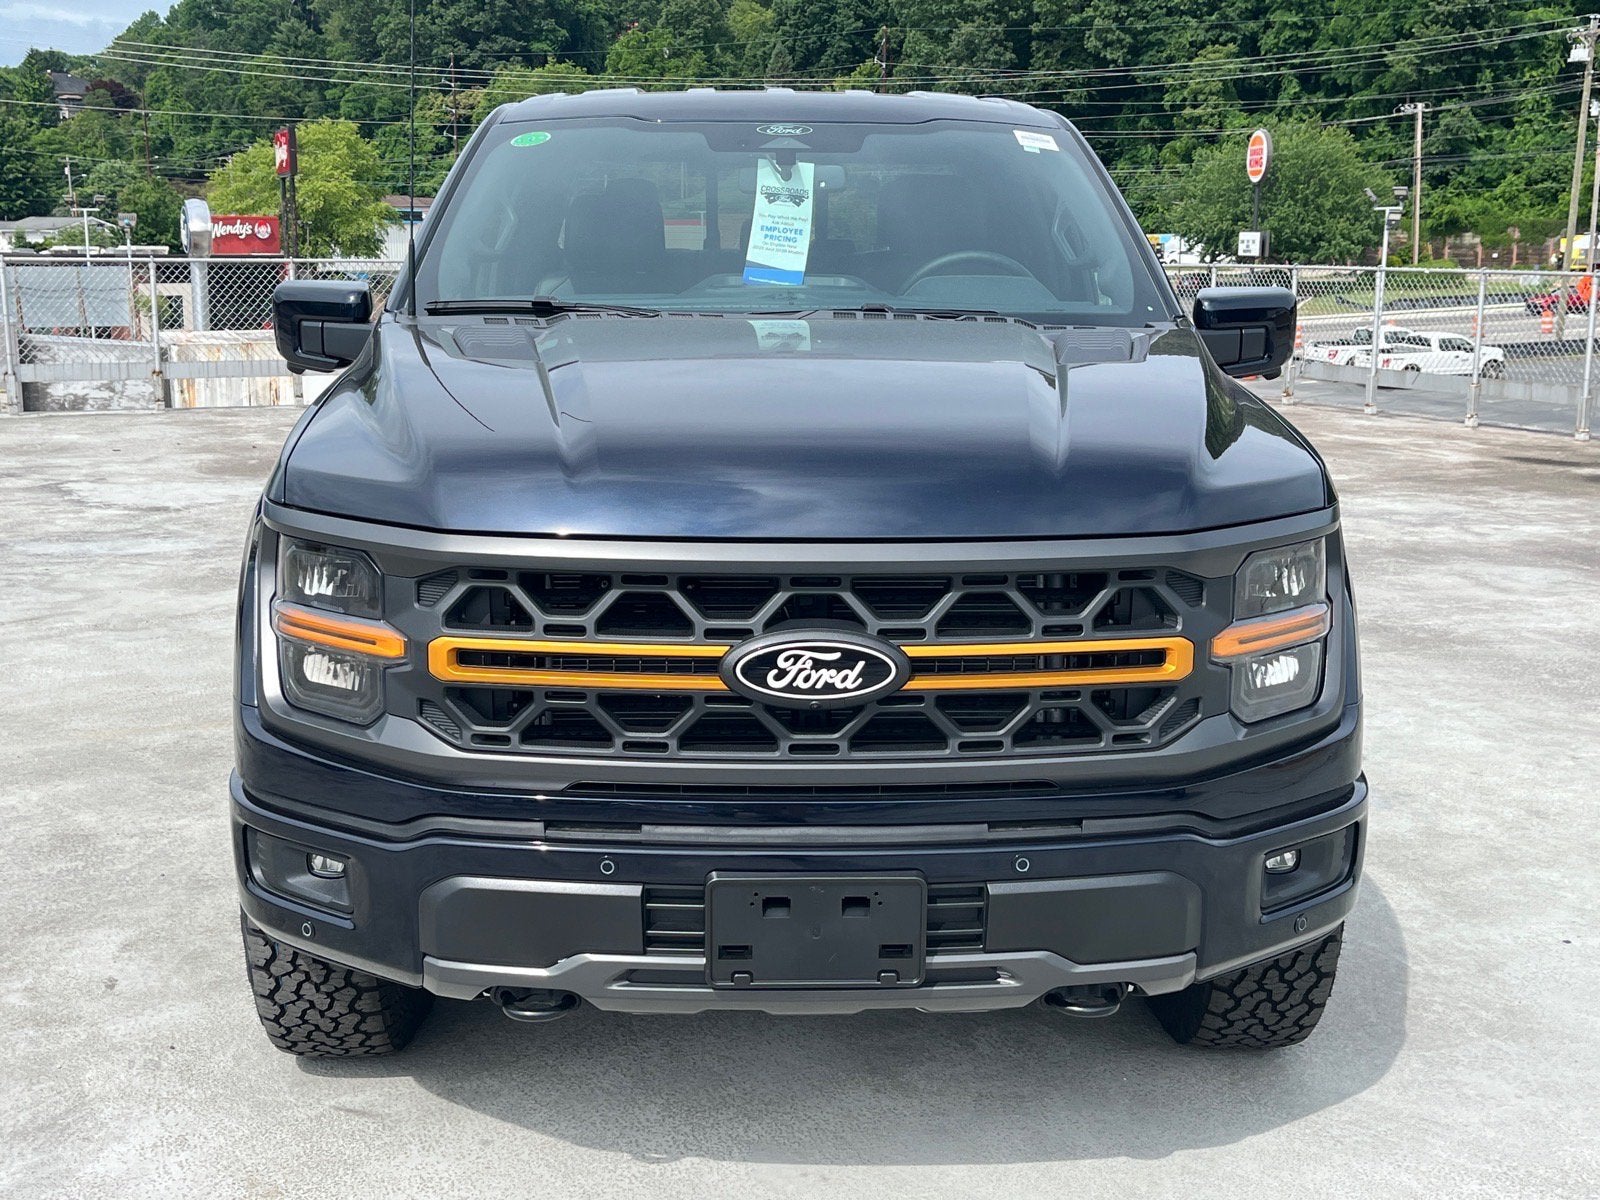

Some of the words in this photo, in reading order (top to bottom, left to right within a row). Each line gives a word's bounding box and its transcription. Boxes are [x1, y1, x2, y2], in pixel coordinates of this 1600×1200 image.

[766, 126, 803, 134] Ford
[1249, 157, 1263, 169] KING
[761, 185, 809, 197] CROSSROADS
[211, 219, 253, 239] Wendy's
[760, 225, 803, 236] EMPLOYEE
[764, 233, 797, 243] PRICING
[766, 650, 866, 690] Ford
